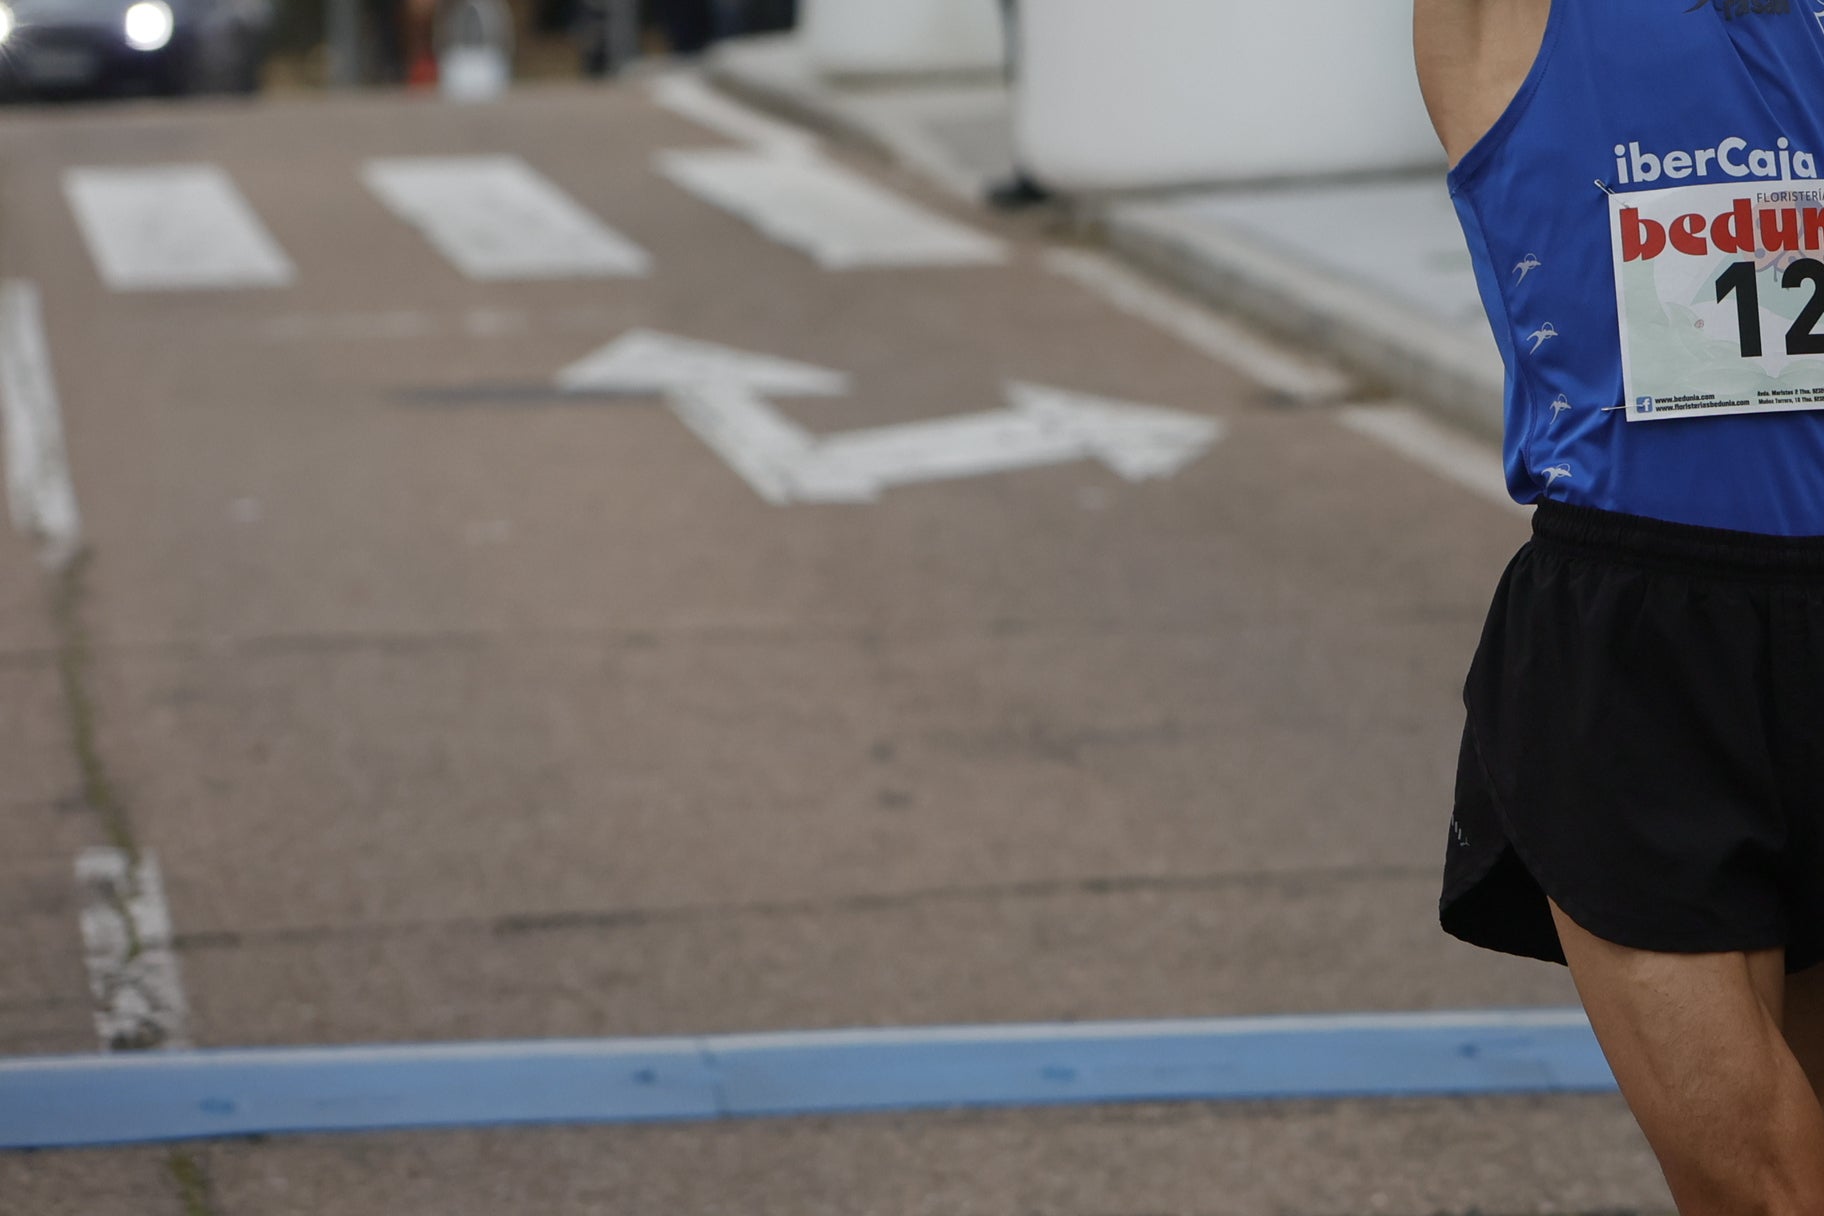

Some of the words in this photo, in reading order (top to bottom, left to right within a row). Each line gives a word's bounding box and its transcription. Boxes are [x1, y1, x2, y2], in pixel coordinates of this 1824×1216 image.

[1614, 136, 1818, 184] iberCaja
[1654, 393, 1715, 404] www.bedunia.com
[1655, 399, 1751, 412] www.floristeriasbedunia.com
